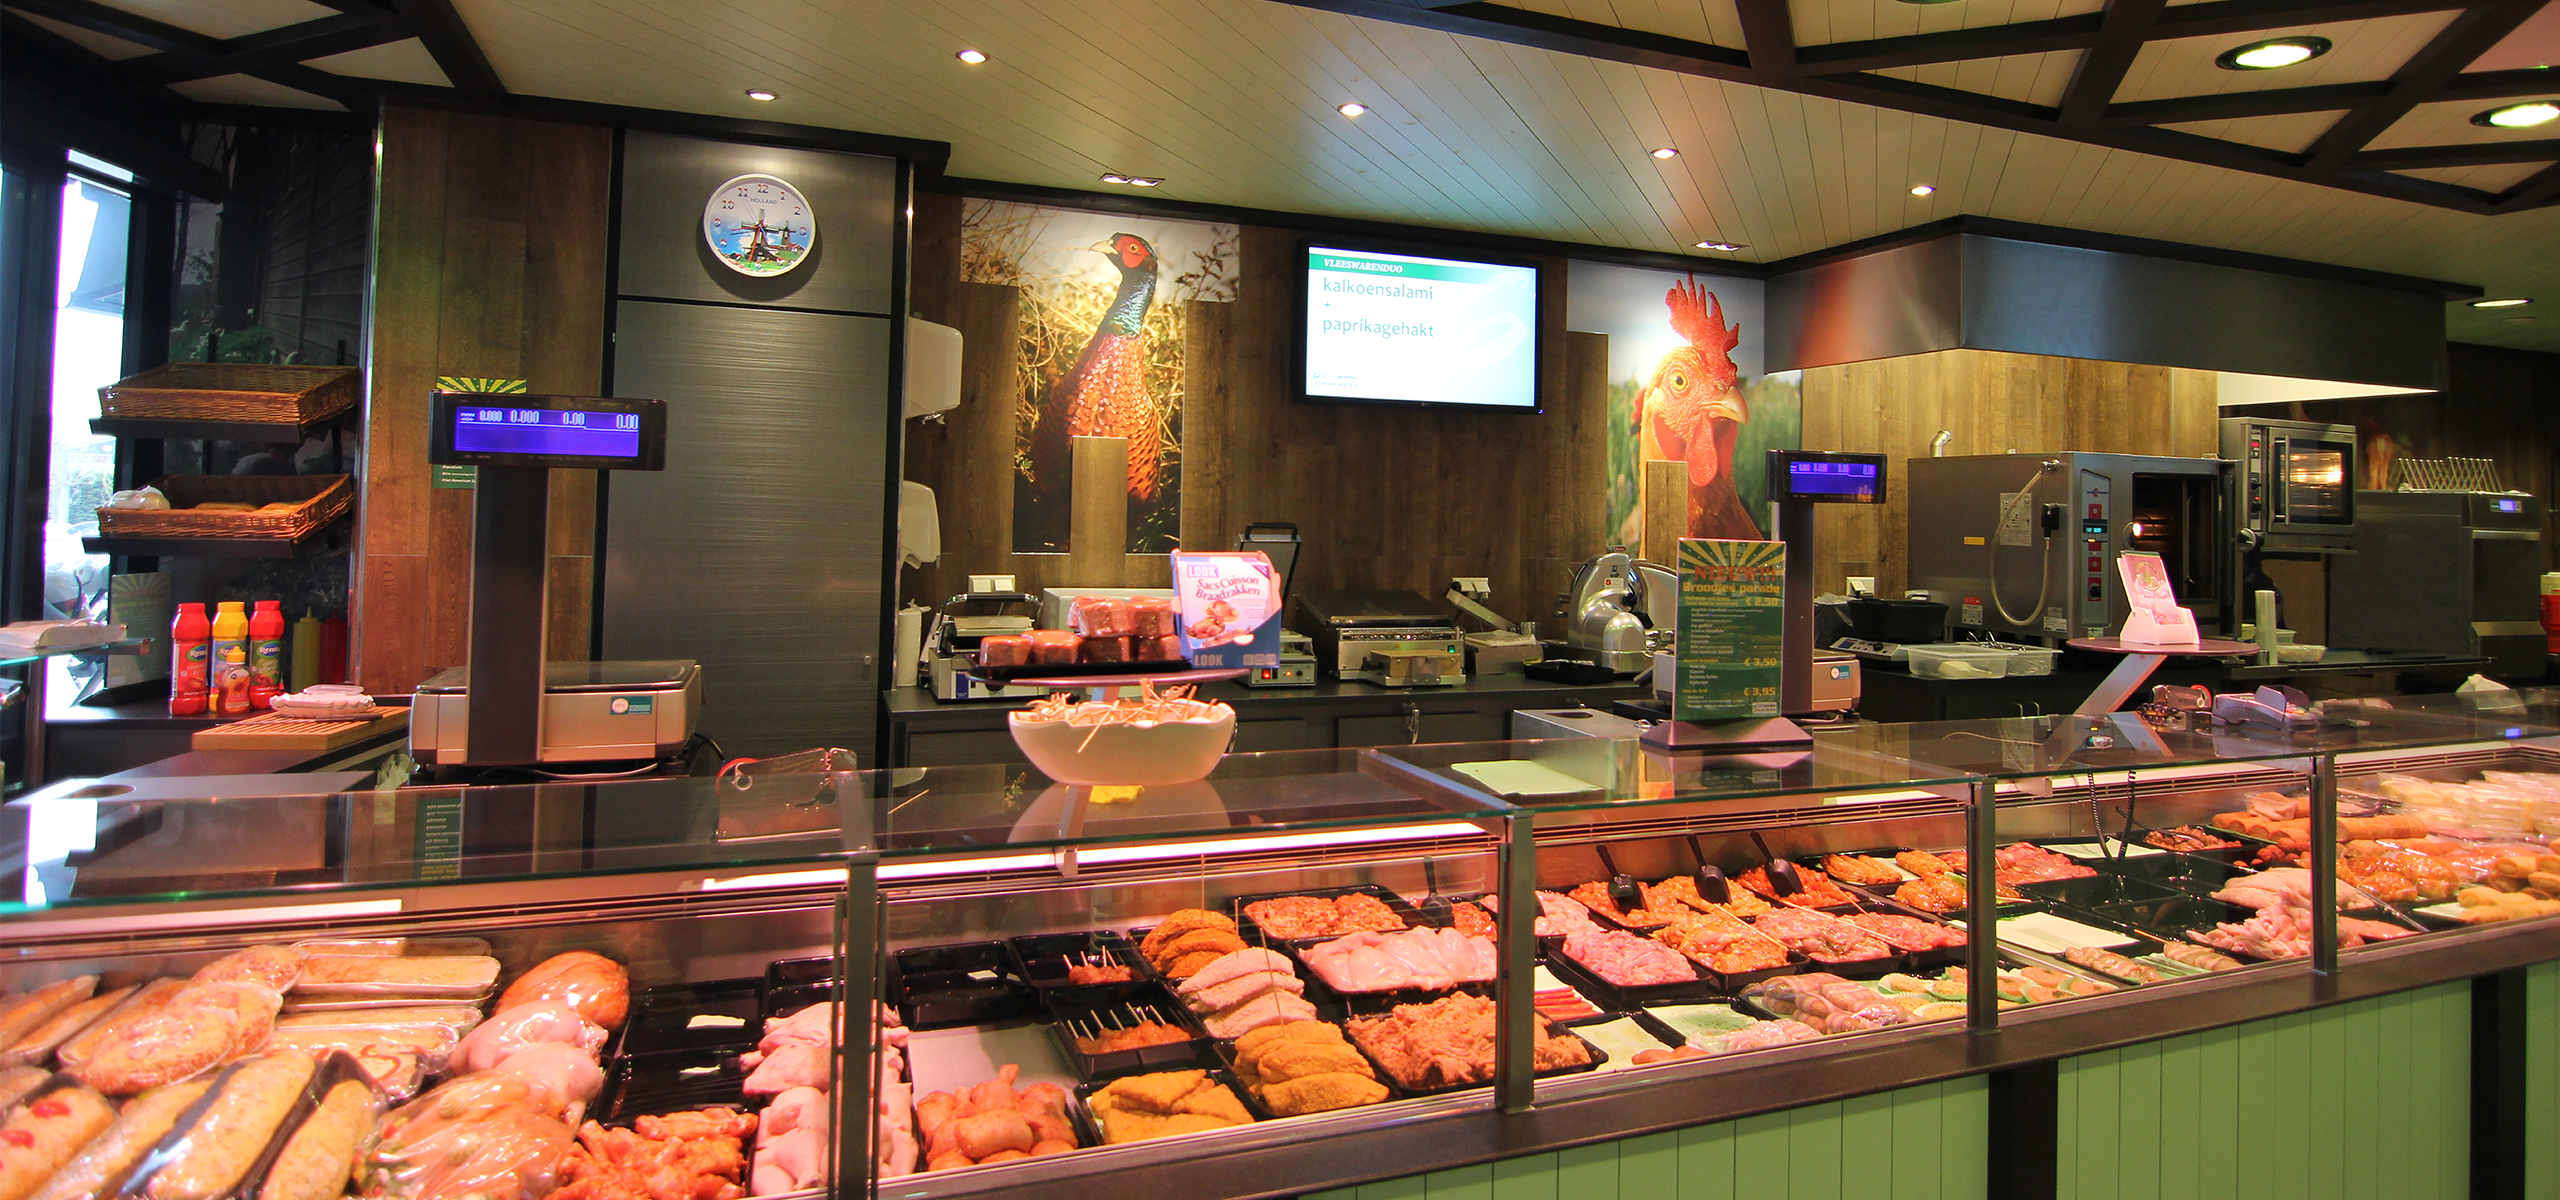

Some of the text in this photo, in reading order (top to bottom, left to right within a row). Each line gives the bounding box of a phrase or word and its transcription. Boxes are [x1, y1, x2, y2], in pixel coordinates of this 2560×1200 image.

[738, 187, 748, 197] 11
[757, 184, 769, 194] 12
[722, 200, 735, 210] 10
[750, 197, 778, 205] HOLLAND
[794, 206, 801, 215] 2
[1323, 258, 1404, 274] VLEESWARENDUO
[1323, 277, 1434, 300] kalkoensalami
[1323, 318, 1434, 339] paprikagehakt
[510, 409, 540, 424] 0.000
[562, 411, 585, 426] 0.00
[616, 413, 639, 430] 0.00
[1188, 565, 1218, 577] LOOK
[1694, 565, 1777, 582] NIEUW!!!
[1196, 575, 1259, 590] Sacs Cuisson
[1195, 584, 1260, 601] Braadzakken
[1682, 581, 1782, 597] Broodjes parade
[1754, 597, 1779, 607] 2,50
[1194, 654, 1224, 667] LOOK
[1753, 657, 1778, 667] 3,50
[1752, 687, 1777, 697] 3,95
